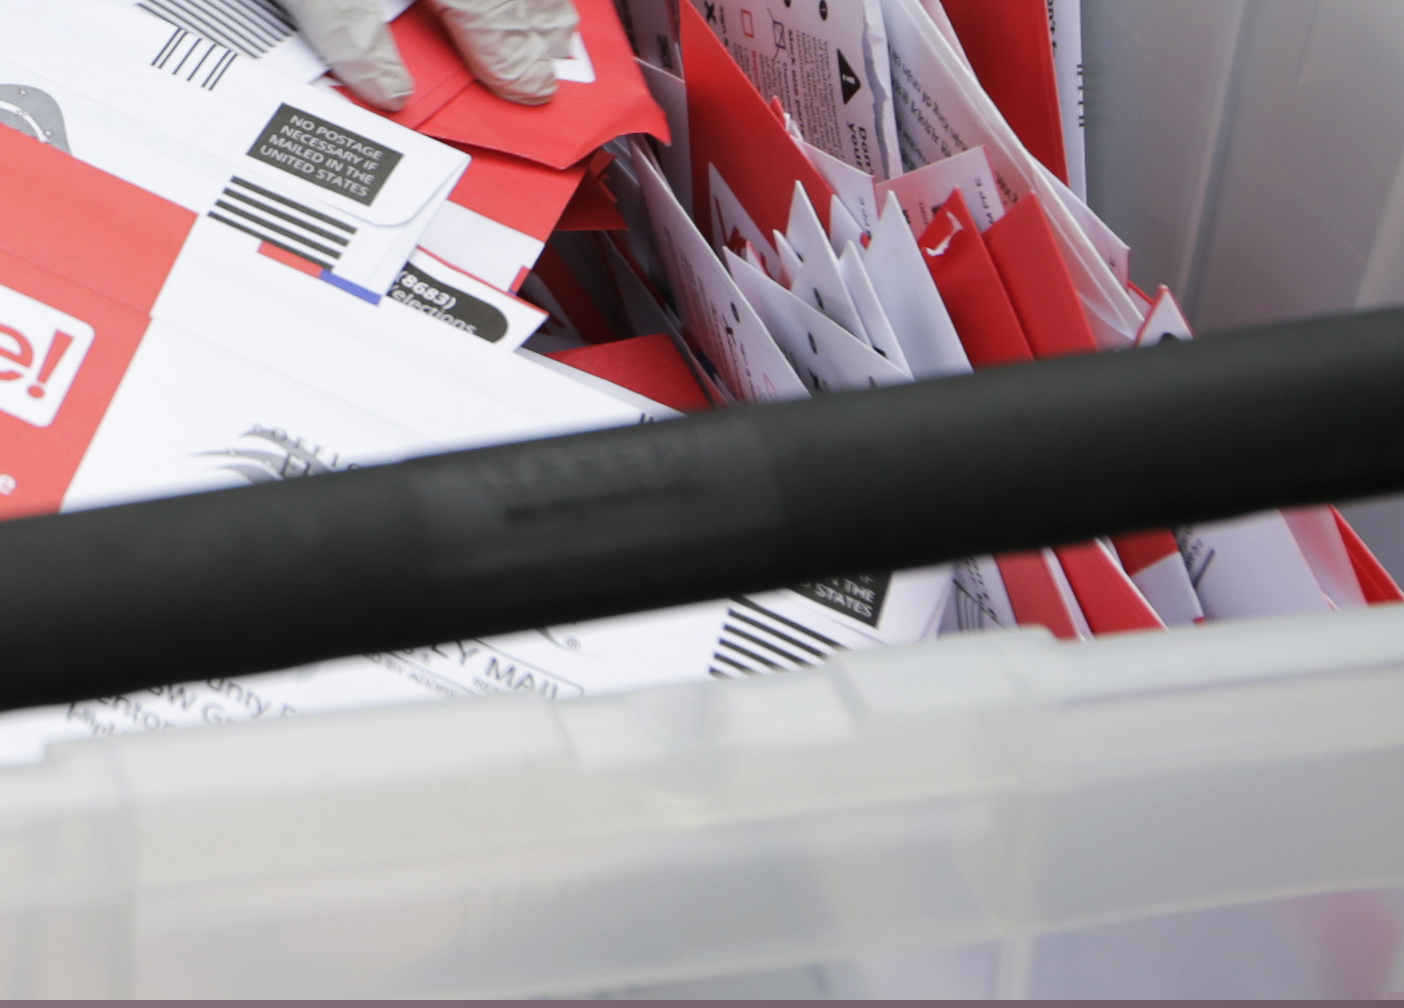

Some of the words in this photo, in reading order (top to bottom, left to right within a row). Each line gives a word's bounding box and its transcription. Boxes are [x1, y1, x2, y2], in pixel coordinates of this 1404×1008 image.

[268, 134, 325, 164] MAILED
[325, 158, 344, 172] IN
[346, 165, 376, 185] THE
[280, 125, 363, 165] NECESSARY
[363, 160, 379, 171] IF
[290, 115, 315, 131] NO
[316, 125, 384, 160] POSTAGE
[259, 144, 315, 174] UNITED
[316, 169, 369, 198] STATES
[815, 582, 873, 618] STATES
